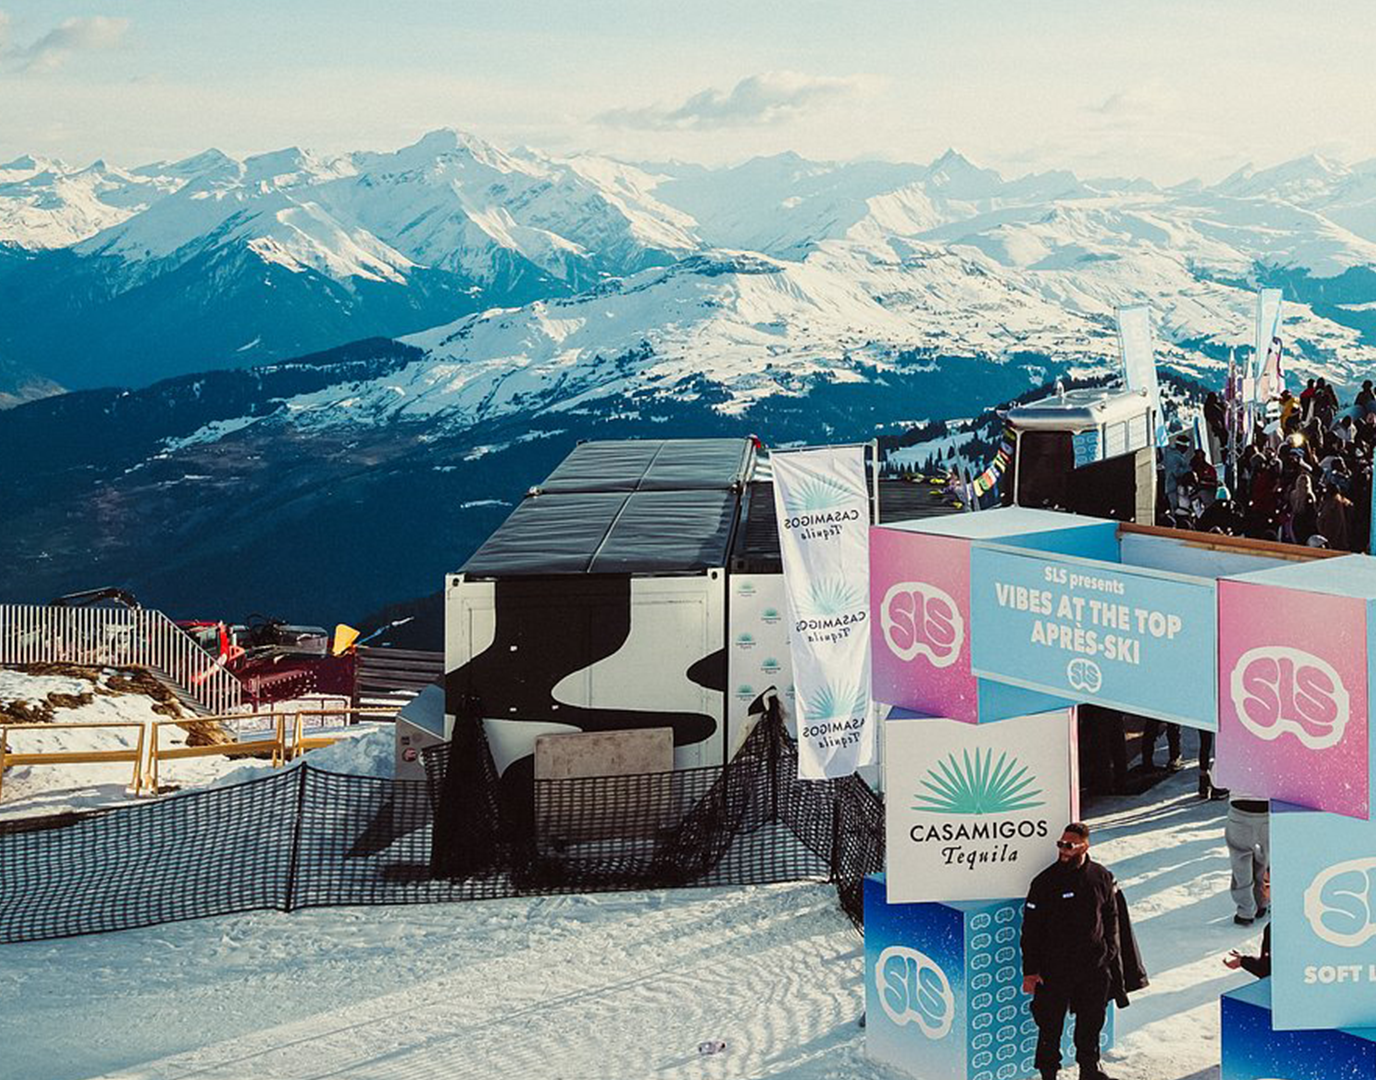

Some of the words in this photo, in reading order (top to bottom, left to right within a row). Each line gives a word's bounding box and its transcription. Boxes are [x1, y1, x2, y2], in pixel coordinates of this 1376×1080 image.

[1045, 566, 1067, 584] SLS
[1070, 573, 1124, 595] presents
[887, 589, 957, 658] SLS
[995, 582, 1052, 615] VIBES
[1057, 595, 1085, 621] AT
[1089, 600, 1130, 631] THE
[1135, 608, 1182, 639] TOP
[1031, 620, 1140, 664] APRÈS-SKI
[1241, 655, 1340, 739] SLS
[910, 820, 1048, 842] CASAMIGOS
[941, 844, 1018, 870] Tequila
[882, 953, 949, 1030] SLS
[1304, 965, 1362, 984] SOFT
